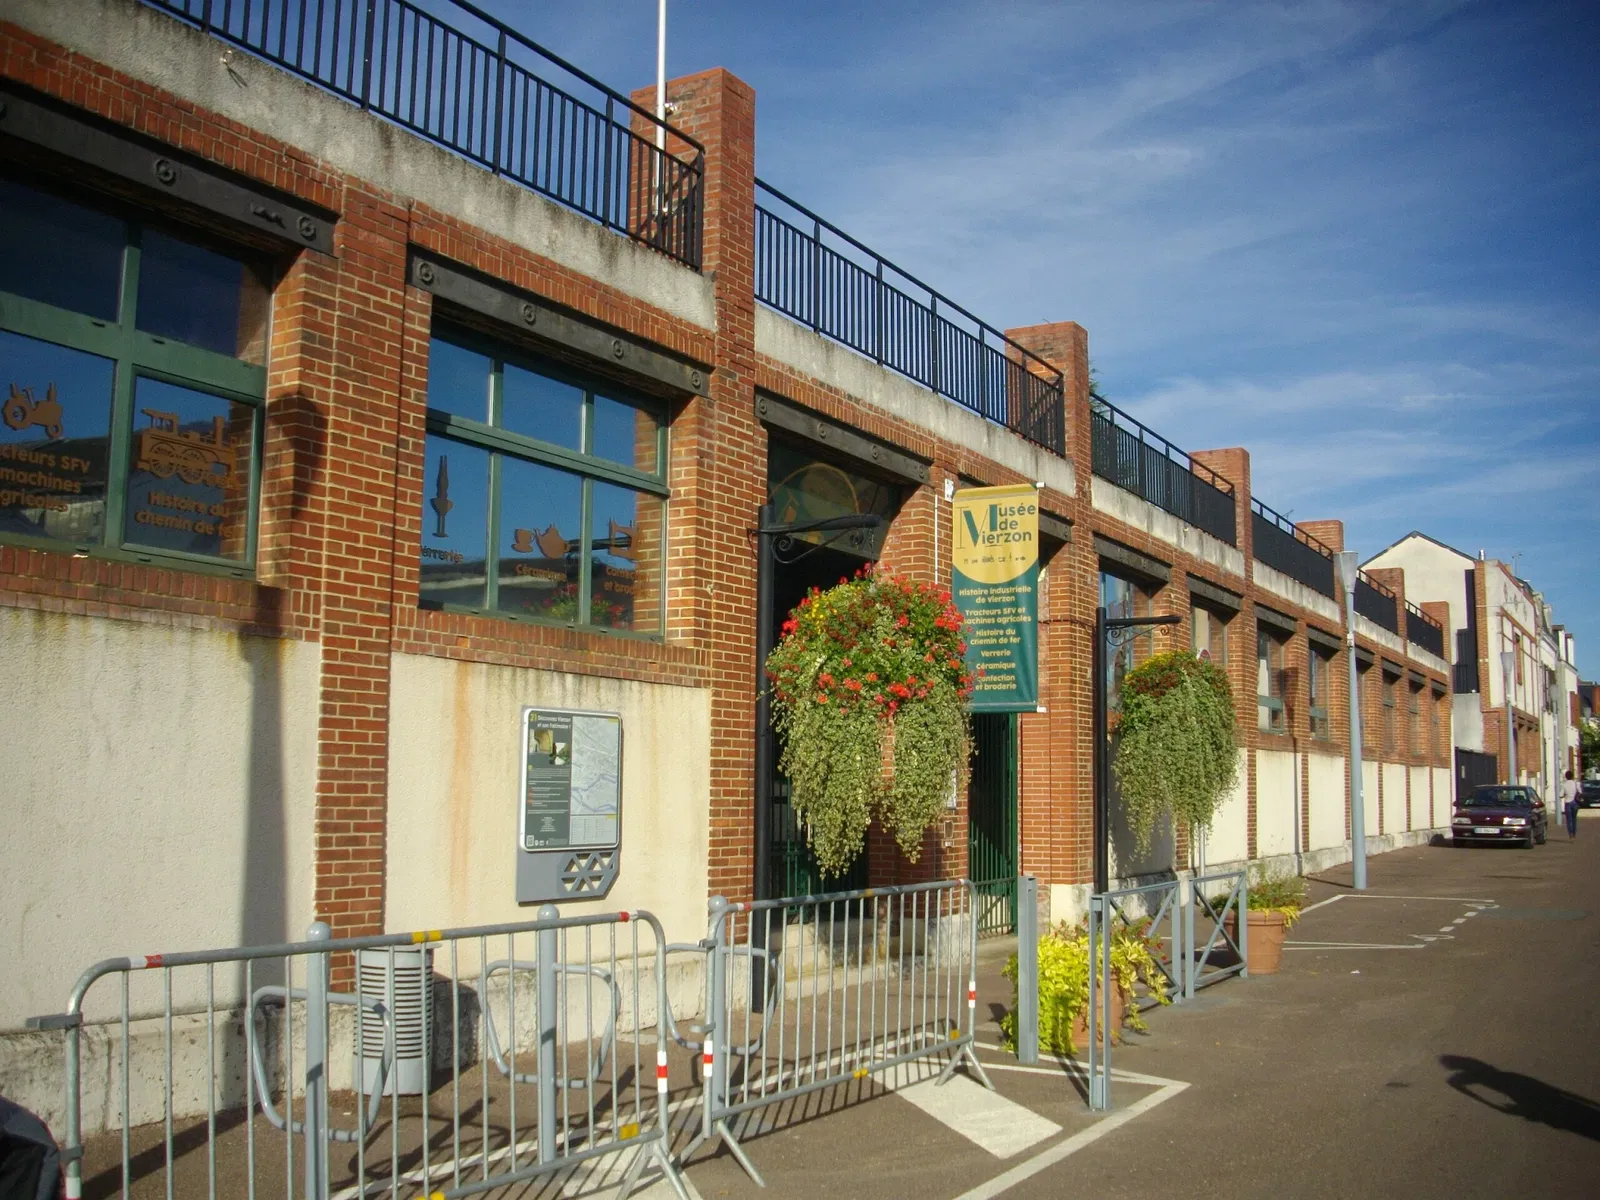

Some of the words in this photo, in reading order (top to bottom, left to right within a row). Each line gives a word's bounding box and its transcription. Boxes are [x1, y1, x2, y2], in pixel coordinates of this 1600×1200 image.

[147, 491, 206, 514] Histoire
[135, 509, 192, 531] chemin
[998, 518, 1019, 531] de
[959, 588, 989, 596] Histoire
[989, 585, 1032, 595] industrielle
[987, 595, 1016, 603] Vierzon
[1003, 607, 1016, 615] SFV
[1017, 606, 1026, 614] et
[996, 614, 1032, 625] agricoles
[976, 629, 1004, 637] Histoire
[970, 637, 997, 645] chemin
[998, 636, 1009, 644] de
[980, 648, 1011, 657] Verrerie
[975, 661, 1016, 670] Céramique
